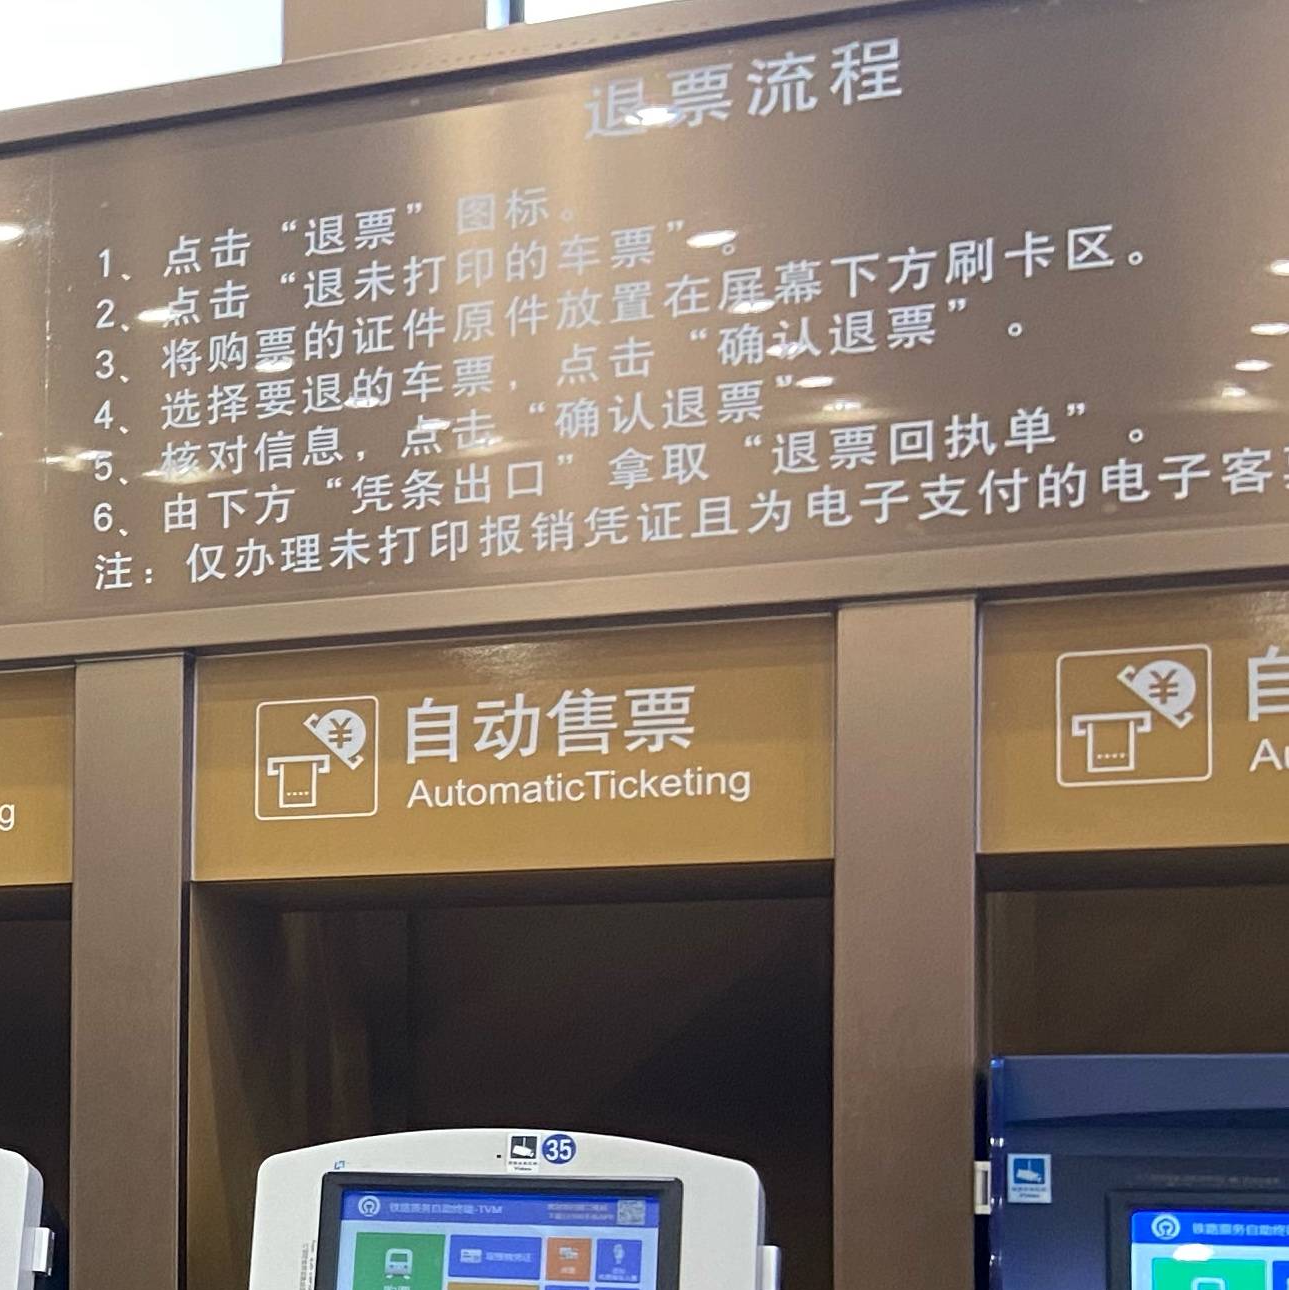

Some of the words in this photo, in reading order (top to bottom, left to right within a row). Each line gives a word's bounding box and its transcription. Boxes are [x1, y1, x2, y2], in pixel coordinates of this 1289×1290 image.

[584, 37, 903, 142] 退票流程
[93, 446, 1289, 590] 注：仅办理未打印报销凭证且为电子支付的电子客
[404, 685, 697, 765] 自动售票
[407, 764, 752, 809] AutomaticTicketing
[546, 1138, 572, 1161] 35
